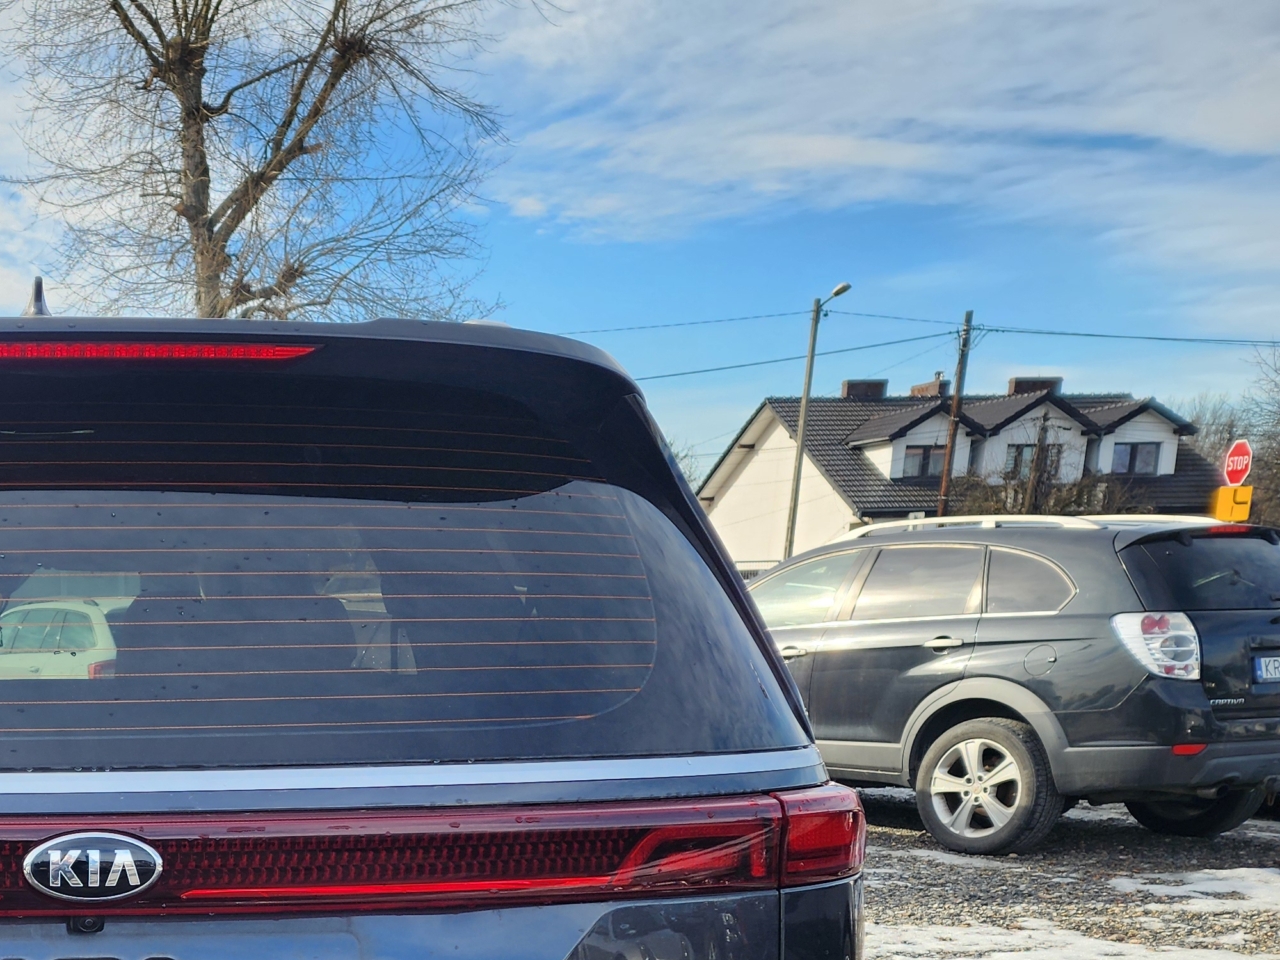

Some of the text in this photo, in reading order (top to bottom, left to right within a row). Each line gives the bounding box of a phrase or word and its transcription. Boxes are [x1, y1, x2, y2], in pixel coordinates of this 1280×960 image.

[1228, 456, 1249, 471] STOP
[1209, 698, 1245, 706] CAPTIVA
[47, 849, 141, 887] KIA
